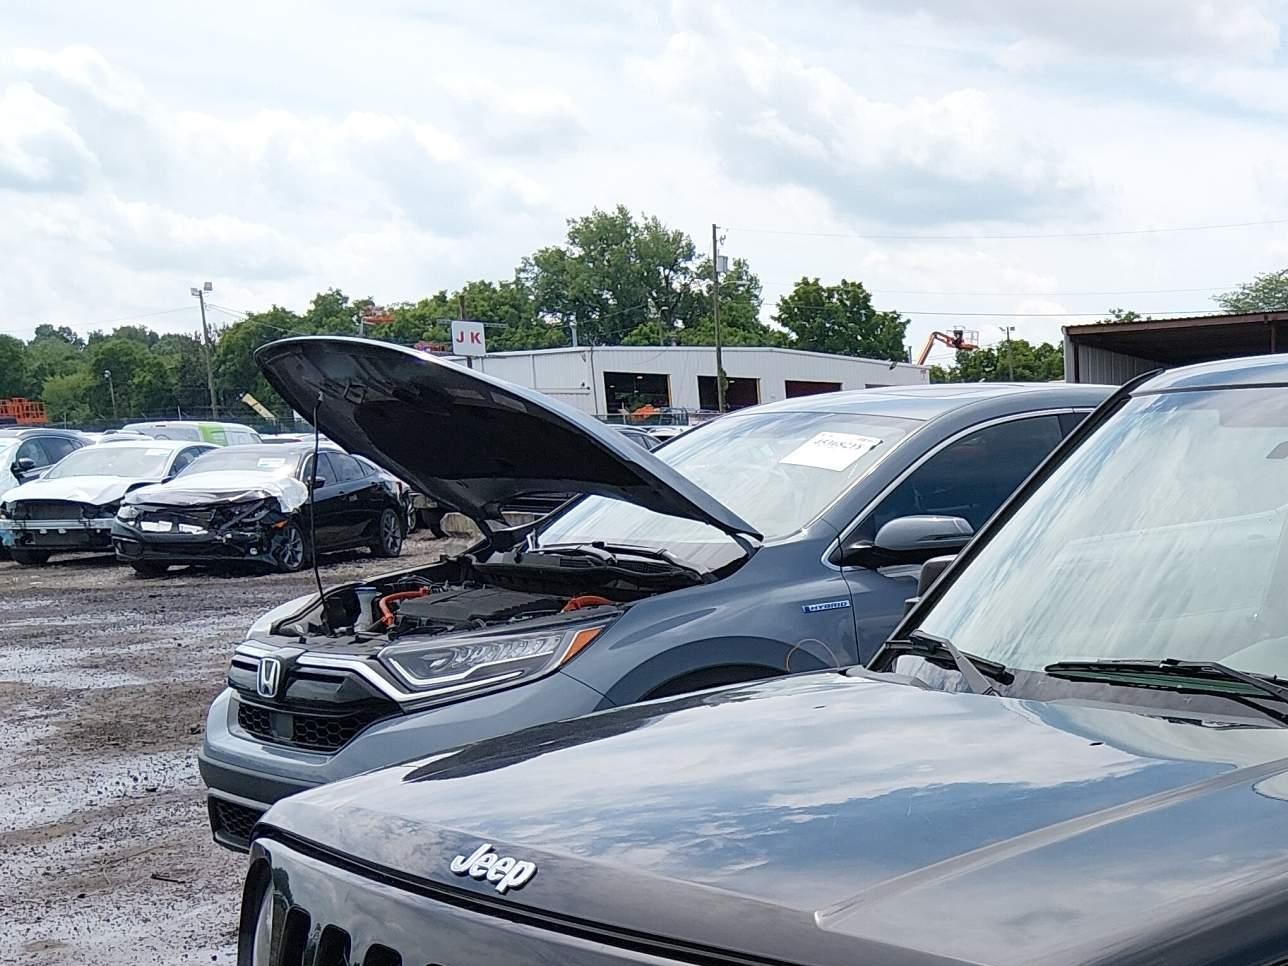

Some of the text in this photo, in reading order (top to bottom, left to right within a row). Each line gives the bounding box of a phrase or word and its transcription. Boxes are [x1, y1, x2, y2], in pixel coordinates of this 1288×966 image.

[455, 331, 482, 345] J K
[809, 600, 850, 611] HYBRID
[450, 843, 537, 894] Jeep
